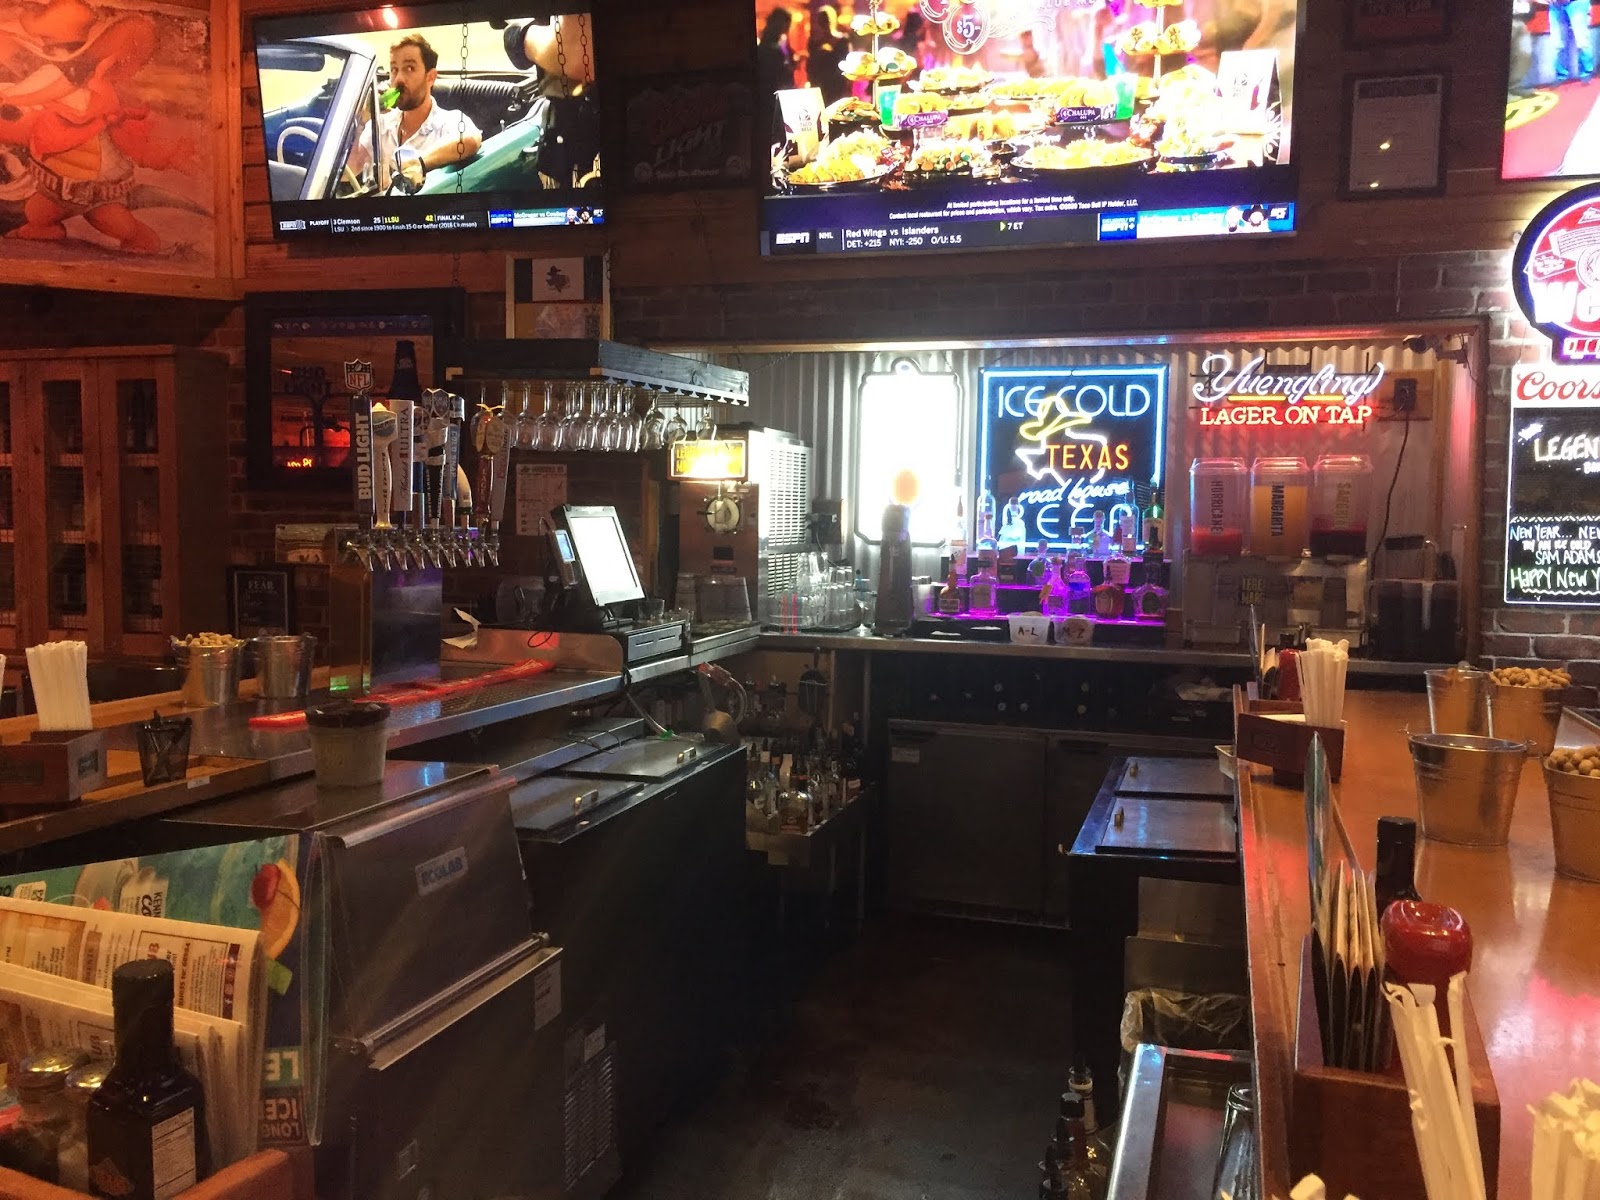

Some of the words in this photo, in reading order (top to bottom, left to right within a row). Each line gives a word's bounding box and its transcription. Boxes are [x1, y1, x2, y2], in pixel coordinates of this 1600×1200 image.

[818, 232, 833, 240] NHL
[845, 229, 862, 238] Red
[862, 228, 887, 238] Wings
[901, 226, 939, 236] Islanders
[1007, 222, 1012, 230] 7
[1013, 221, 1023, 230] ET
[846, 239, 863, 248] DET:
[863, 239, 882, 247] +215
[889, 238, 904, 246] NYI:
[905, 237, 923, 246] -250
[930, 236, 949, 245] O/U:
[949, 235, 962, 243] 5.5
[349, 372, 370, 387] NFL
[1192, 353, 1386, 406] Yuengling
[998, 385, 1046, 418] ICE
[1055, 384, 1151, 417] COLD
[1199, 406, 1283, 426] LAGER
[1285, 405, 1320, 425] ON
[1325, 405, 1372, 424] TAP
[355, 412, 371, 463] LIGHT
[400, 406, 409, 454] ULTRA
[1045, 444, 1130, 470] TEXAS
[357, 463, 372, 500] BUD
[1018, 477, 1072, 505] road
[1068, 476, 1130, 508] house
[1210, 480, 1224, 533] HURRICANE
[1270, 484, 1285, 537] MARGARITA
[1535, 550, 1560, 566] SAM
[1017, 626, 1038, 636] A-L
[1063, 626, 1085, 639] M-Z
